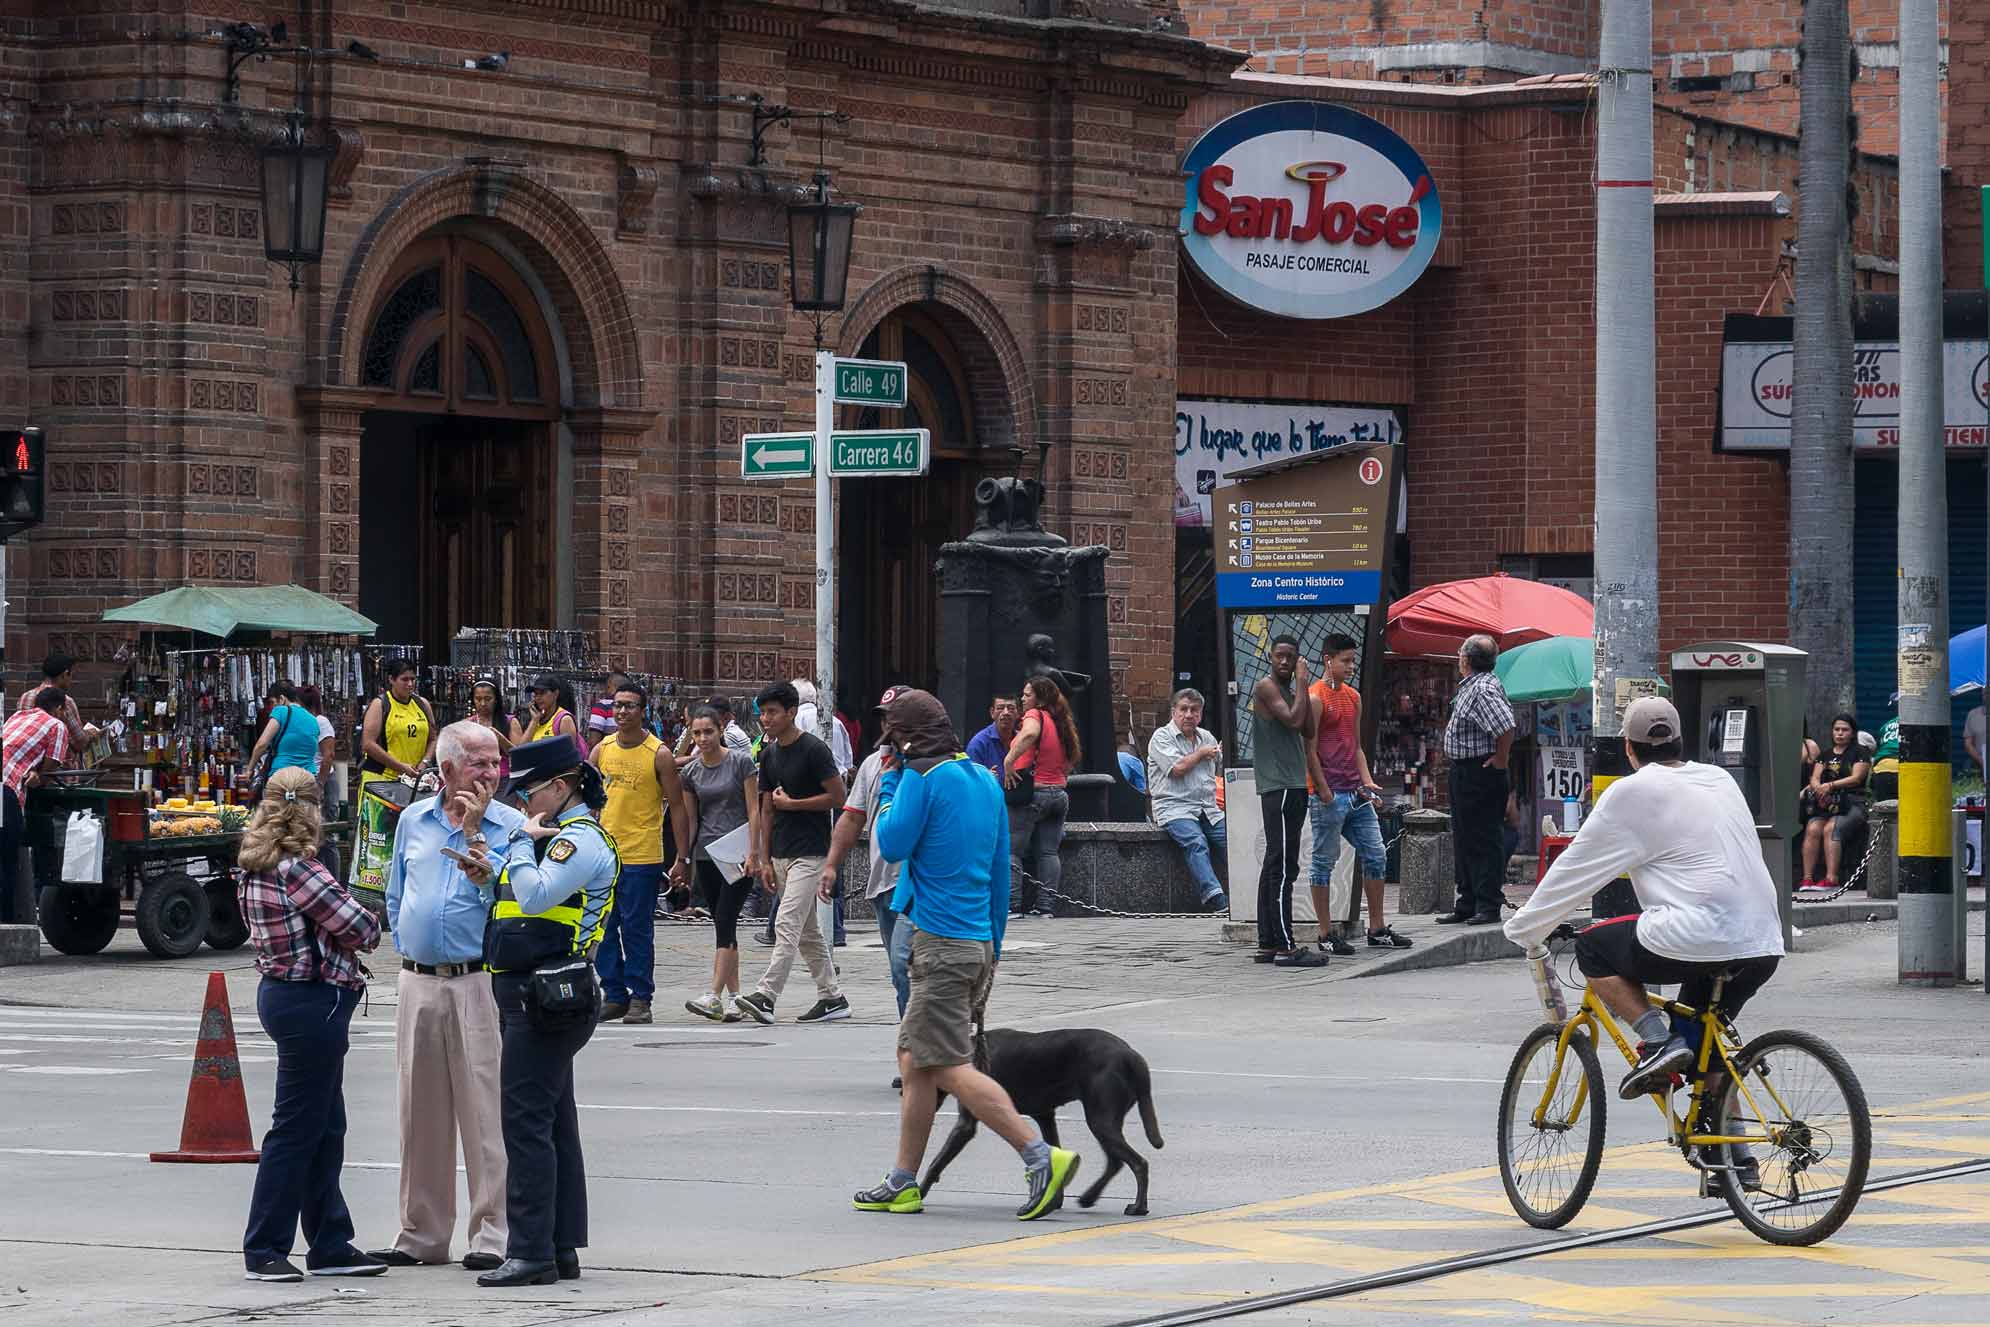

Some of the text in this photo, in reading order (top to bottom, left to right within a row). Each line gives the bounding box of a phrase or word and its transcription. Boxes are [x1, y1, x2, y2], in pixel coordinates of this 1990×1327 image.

[1193, 164, 1432, 249] San José
[1246, 252, 1371, 275] PASAJE COMERCIAL
[842, 370, 898, 396] Calle 49
[1252, 429, 1282, 460] que
[1289, 418, 1303, 452] lo
[838, 441, 913, 466] Carrera 46
[1274, 518, 1289, 526] Pablo
[1255, 536, 1309, 545] Parque Bicentenario
[1300, 553, 1324, 561] Memoria
[1251, 576, 1344, 588] Zona Centro Histórico
[1276, 593, 1318, 601] Historic Center
[1693, 654, 1742, 667] une
[407, 724, 417, 738] 12
[1547, 769, 1583, 799] 150
